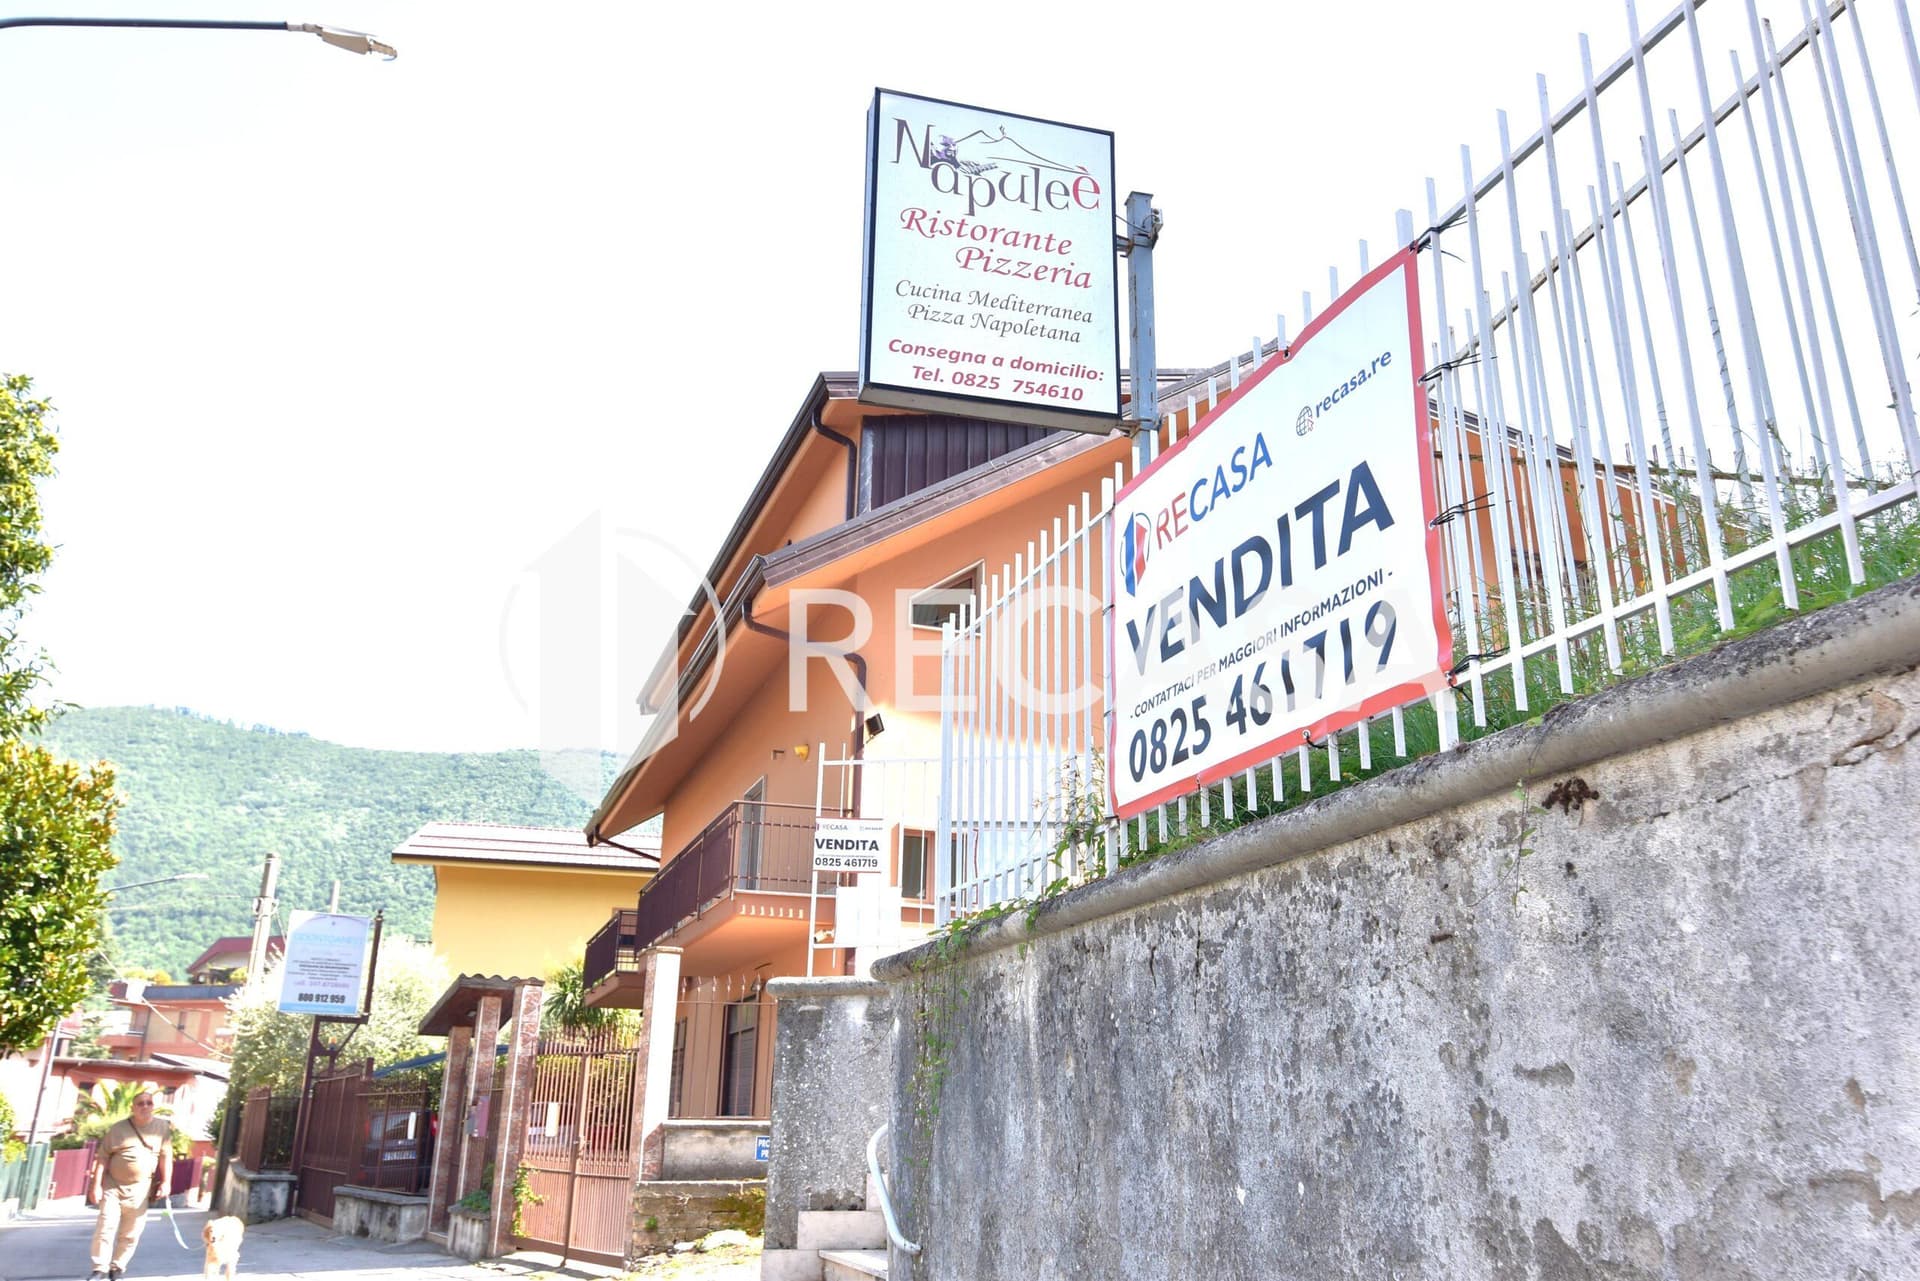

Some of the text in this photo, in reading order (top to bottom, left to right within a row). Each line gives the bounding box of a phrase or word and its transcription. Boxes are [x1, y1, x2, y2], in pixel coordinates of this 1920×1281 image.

[900, 207, 1073, 255] Ristorante
[955, 246, 1092, 289] Pizzeria
[895, 279, 1093, 324] Cucina Mediterranea
[907, 303, 1081, 344] Pizza Napoletana
[888, 338, 1104, 382] Consegna a domicilio:
[912, 365, 1084, 401] Tel. 0825 754610
[1315, 351, 1392, 418] recasa.re
[1156, 432, 1272, 550] RECASA
[1126, 460, 1395, 677] VENDITA
[1134, 675, 1194, 718] CONTATTACI
[1197, 663, 1216, 684] PER
[1219, 628, 1277, 672] MAGGIORI
[1281, 568, 1383, 638] INFORMAZIONI
[1129, 600, 1397, 783] 0825 461719
[815, 838, 880, 851] VENDITA
[815, 857, 878, 868] 0825 461719
